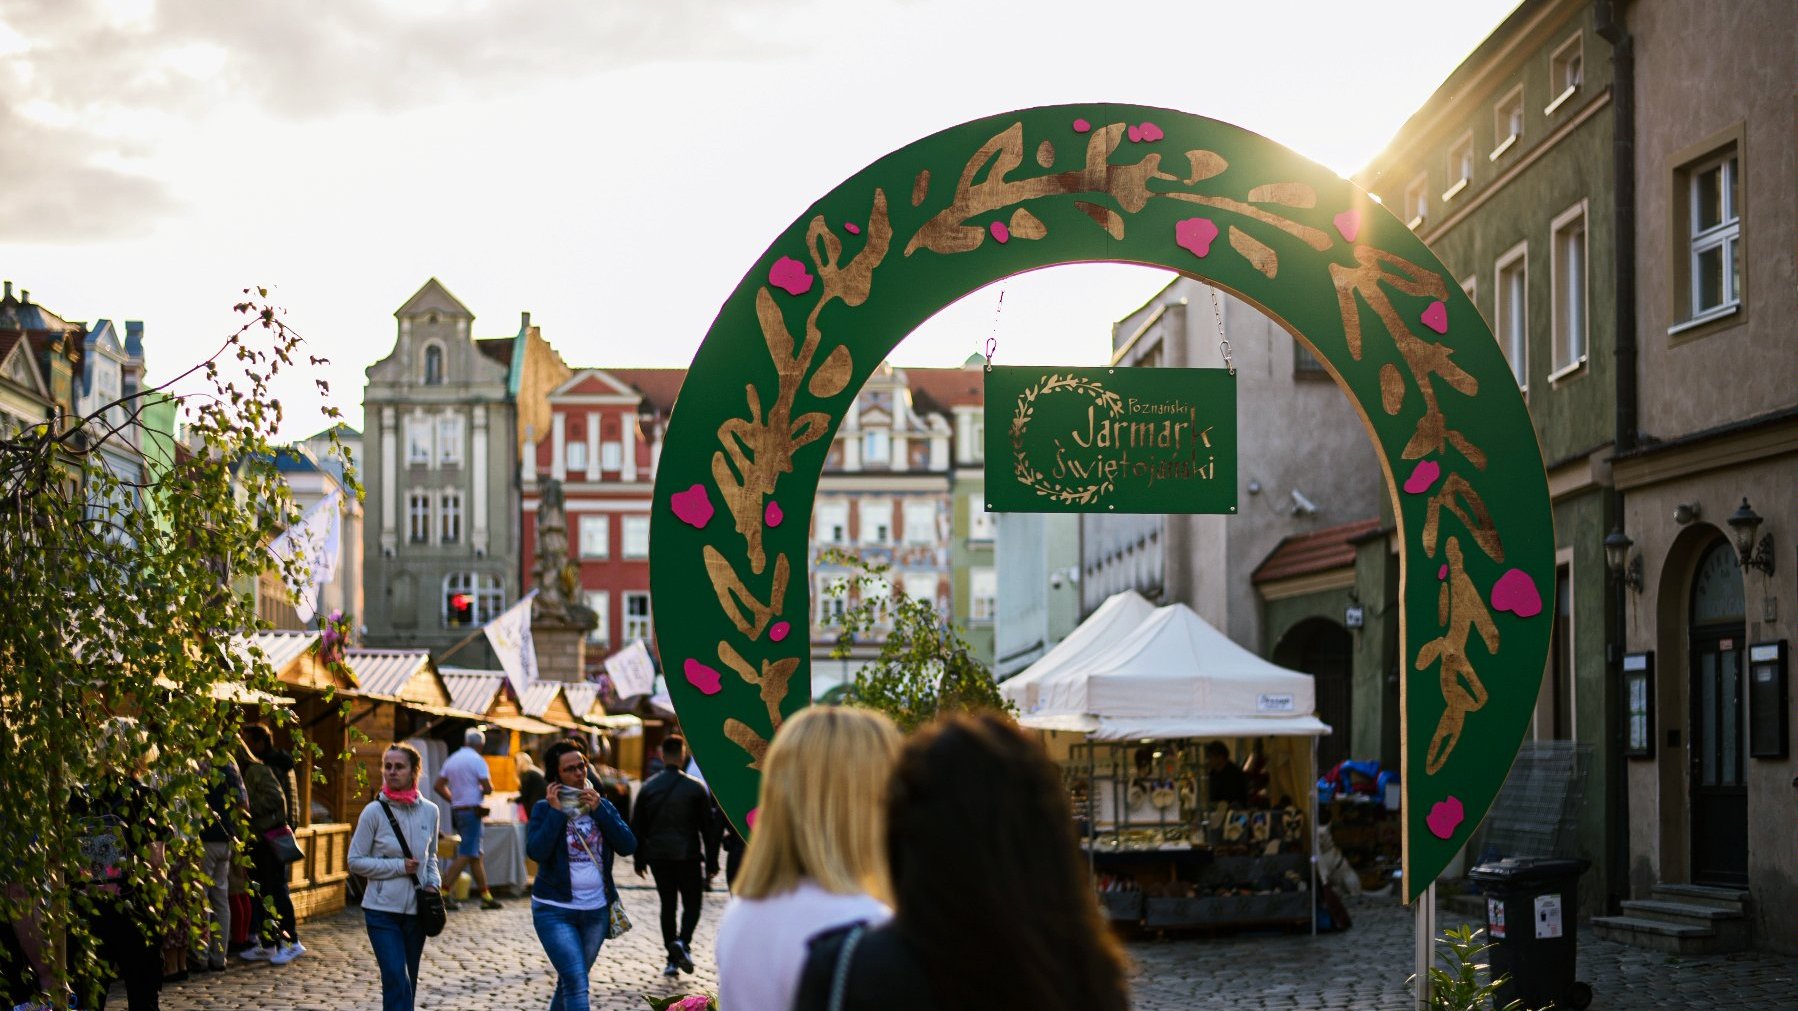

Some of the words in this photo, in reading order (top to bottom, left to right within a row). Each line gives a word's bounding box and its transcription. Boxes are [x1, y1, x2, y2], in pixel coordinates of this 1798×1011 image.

[1072, 405, 1214, 448] Jarmark
[1129, 398, 1188, 415] Poznański
[1052, 439, 1215, 488] Świętojański
